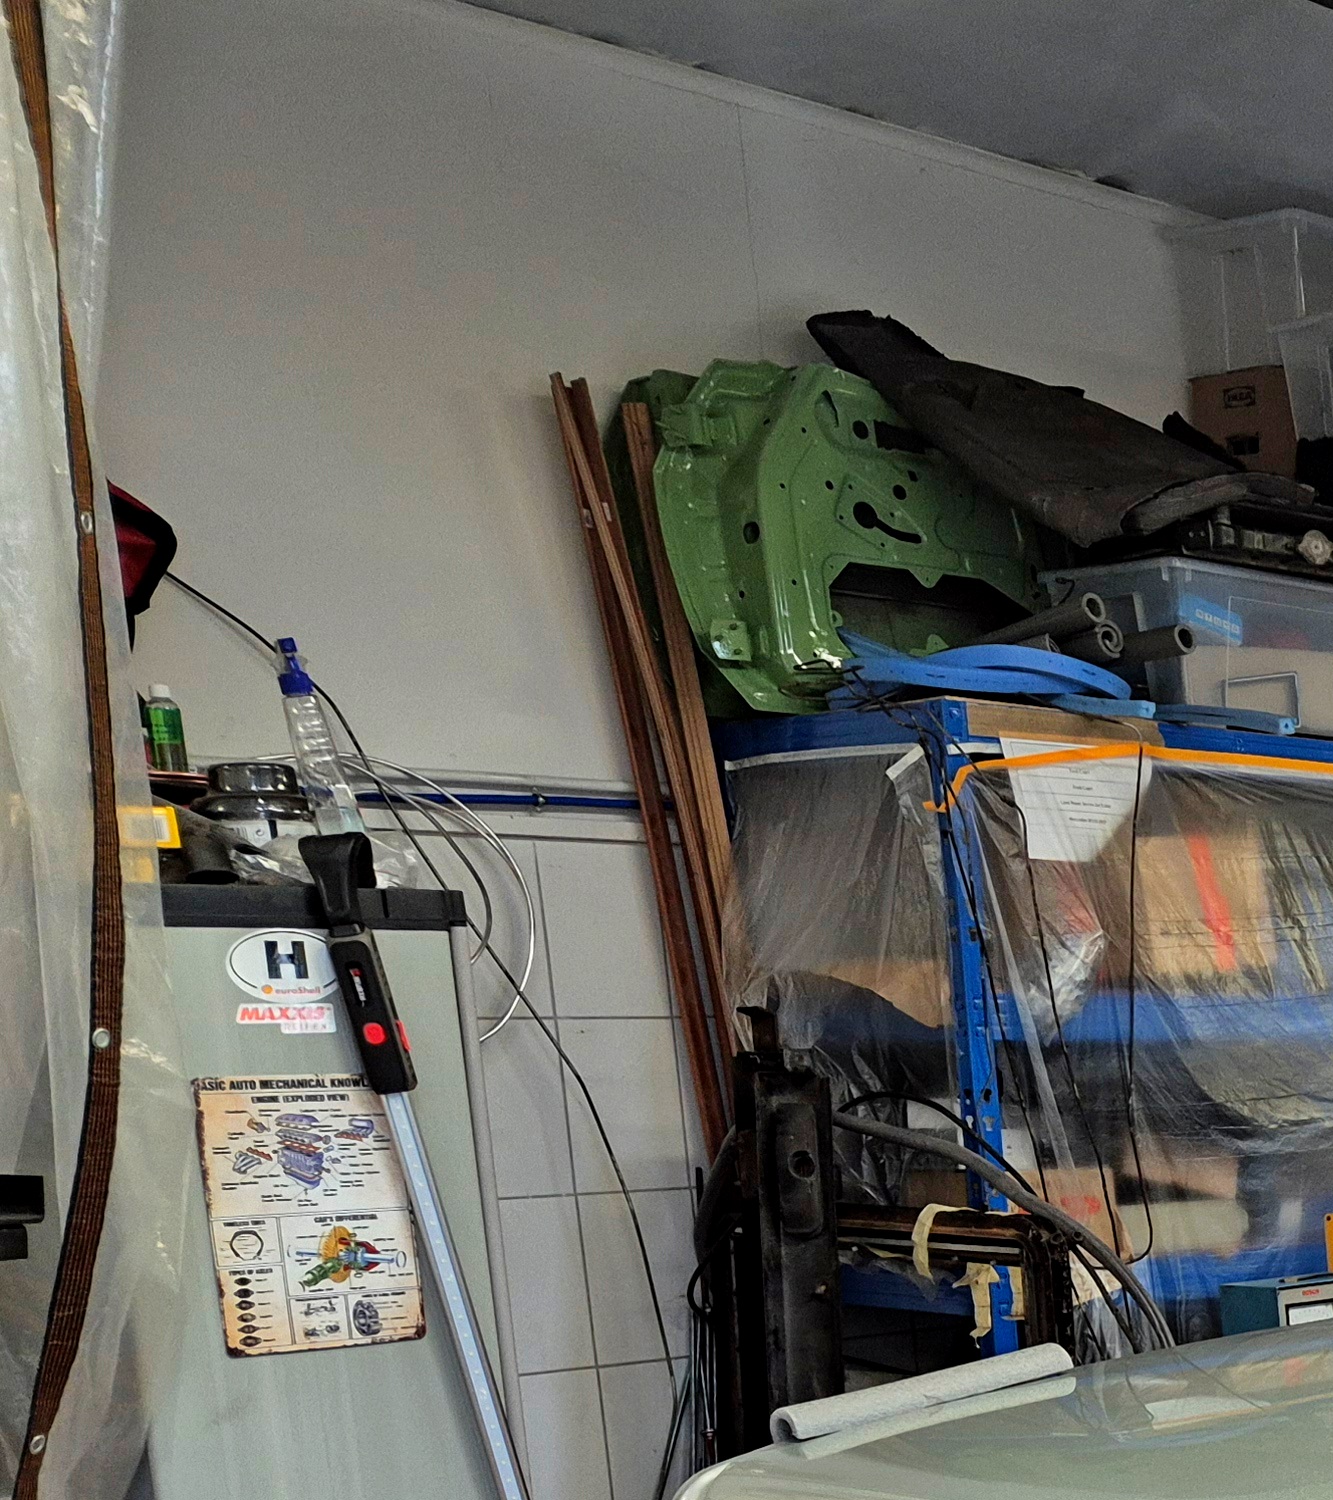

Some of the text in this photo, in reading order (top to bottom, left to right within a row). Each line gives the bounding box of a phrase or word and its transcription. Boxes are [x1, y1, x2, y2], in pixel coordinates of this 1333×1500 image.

[264, 940, 310, 979] H
[275, 986, 321, 995] euroShell
[239, 1007, 326, 1021] MAXXIS
[229, 1080, 257, 1091] AUTO
[259, 1078, 328, 1090] MECHANICAL
